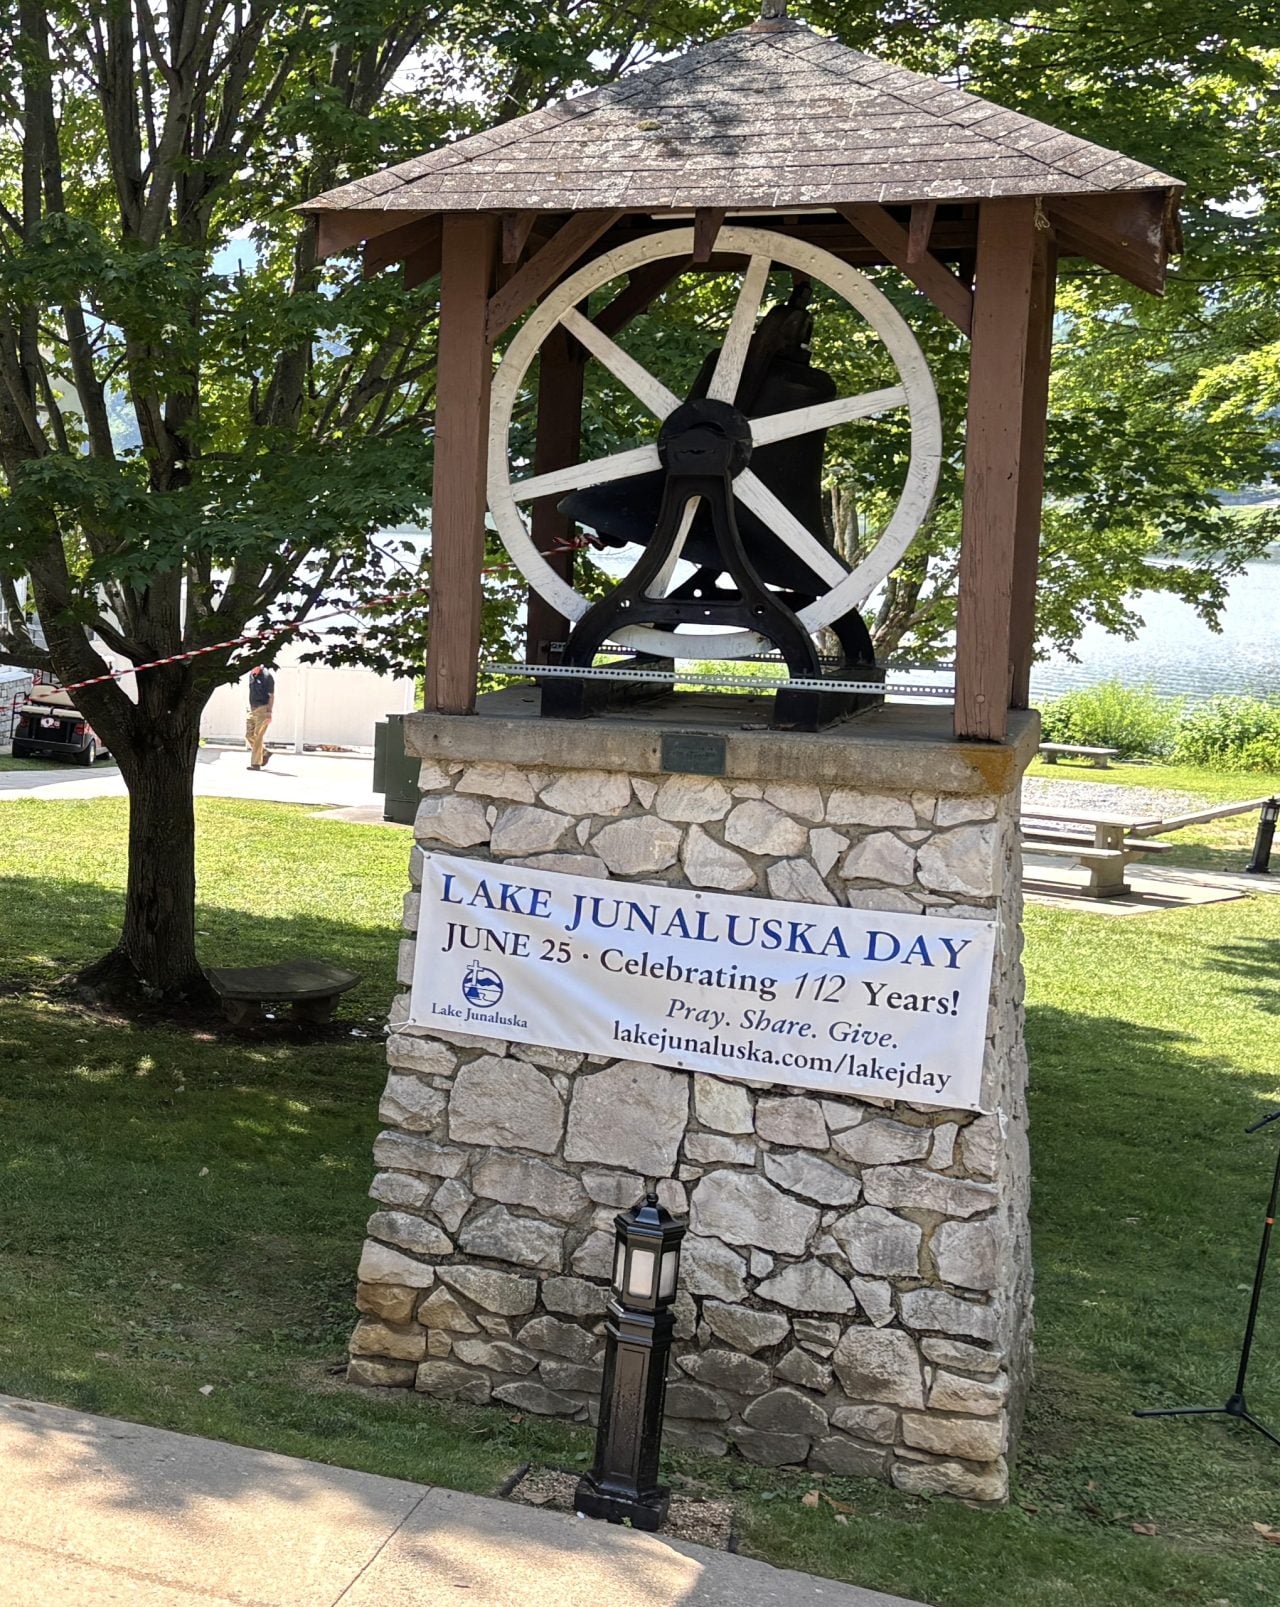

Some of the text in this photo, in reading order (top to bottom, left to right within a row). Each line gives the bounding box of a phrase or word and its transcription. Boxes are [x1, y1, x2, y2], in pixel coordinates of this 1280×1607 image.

[440, 874, 972, 970] LAKE JUNALUSKA DAY
[442, 922, 961, 1016] JUNE 25 Celebrating 112 Years!
[432, 1002, 528, 1028] Lake Junaluska
[666, 999, 898, 1048] Pray. Share. Give.
[614, 1022, 951, 1092] lakejunaluska.com/lakejday
